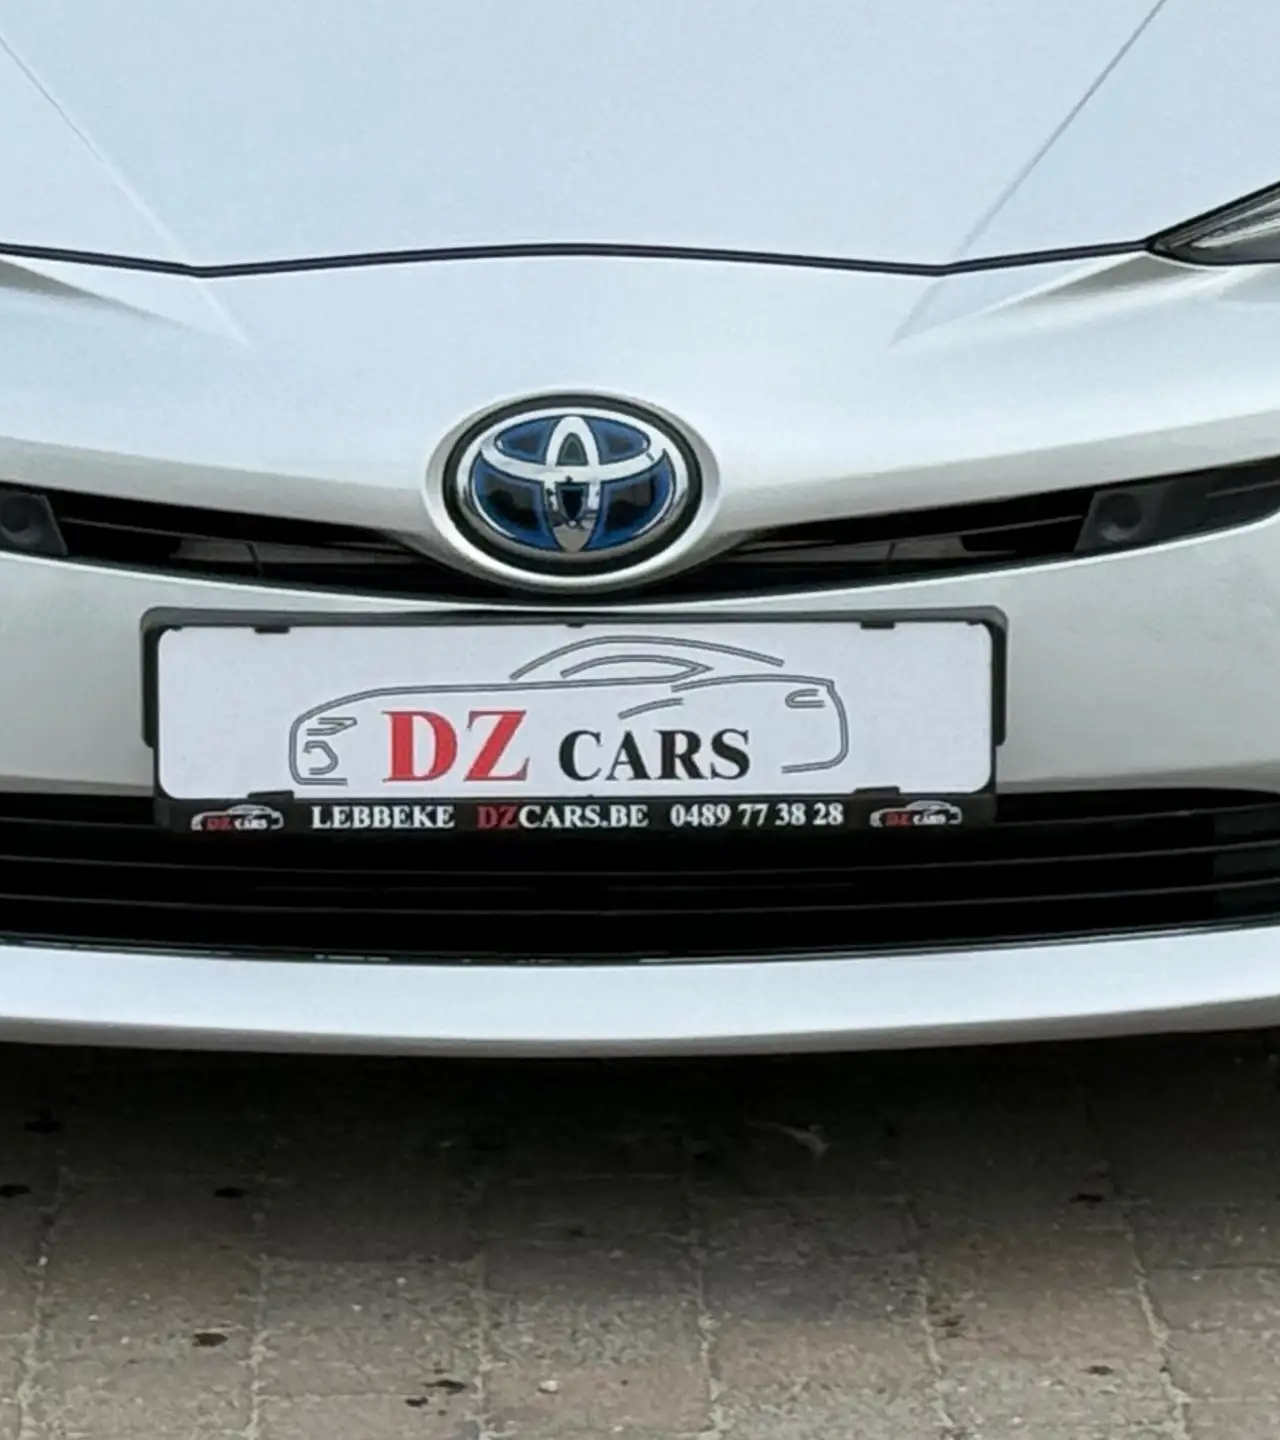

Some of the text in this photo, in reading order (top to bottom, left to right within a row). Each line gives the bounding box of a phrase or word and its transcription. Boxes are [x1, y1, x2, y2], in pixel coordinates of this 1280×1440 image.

[381, 709, 751, 783] DZ CARS
[311, 802, 844, 829] LEBBEKE DZCARS.BE 0489 77 38 28
